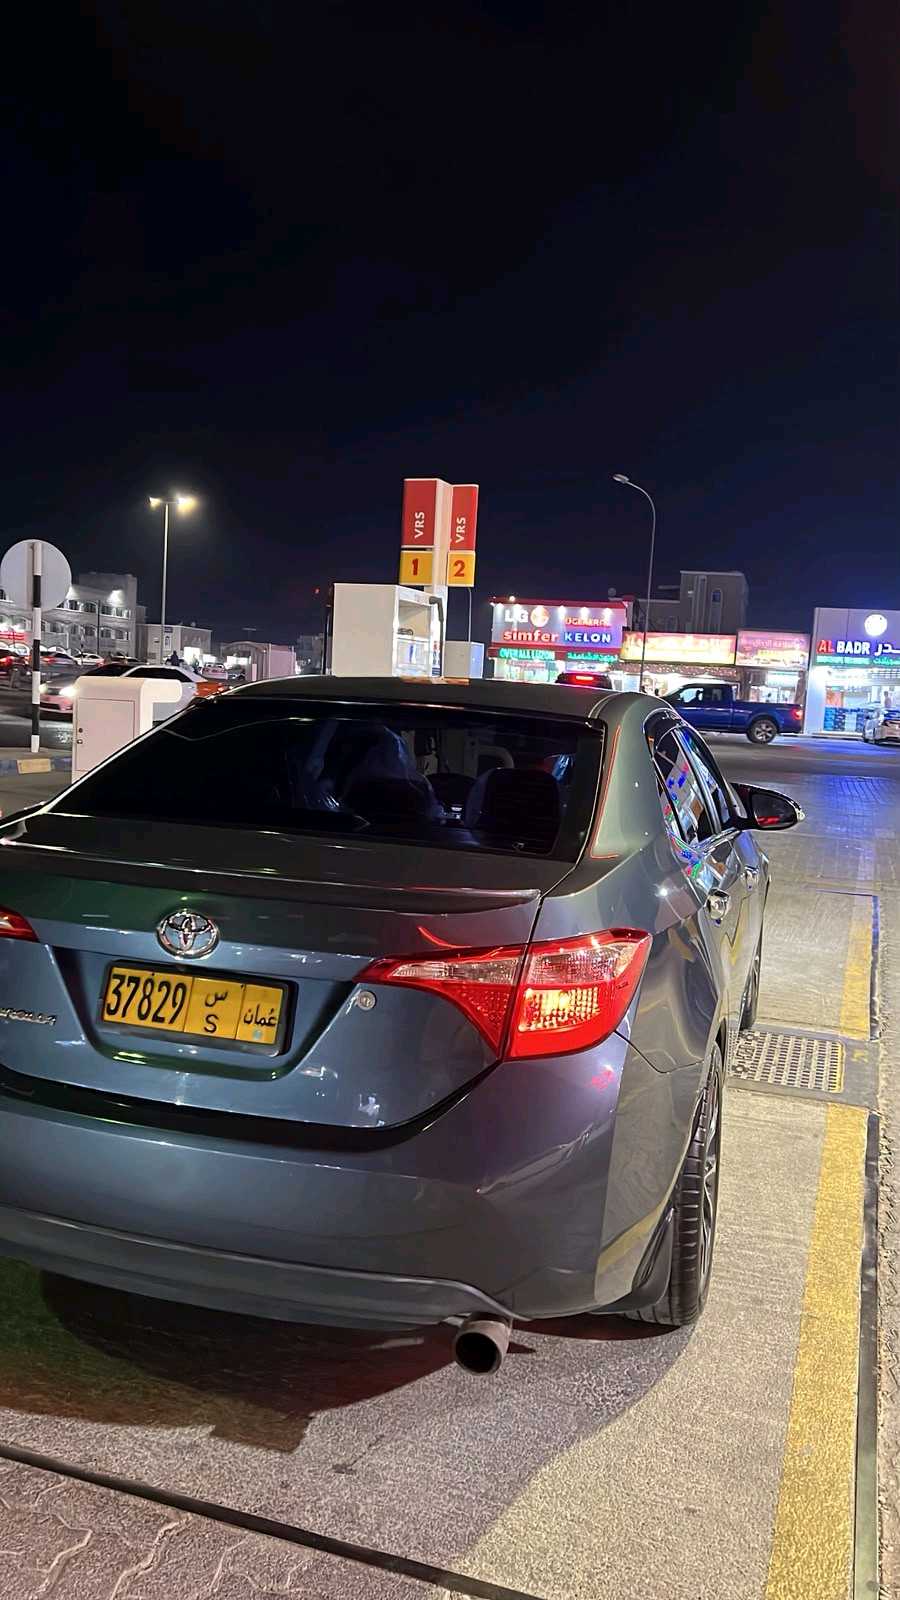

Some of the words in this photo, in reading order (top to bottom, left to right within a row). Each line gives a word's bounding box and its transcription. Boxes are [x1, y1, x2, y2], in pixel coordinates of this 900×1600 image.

[415, 511, 425, 539] VRS
[455, 516, 466, 543] VRS
[411, 558, 419, 576] 1
[453, 560, 466, 577] 2
[504, 609, 529, 623] LG
[503, 629, 559, 641] simfer
[564, 632, 611, 643] KELON
[818, 640, 834, 653] AL
[836, 641, 870, 654] BADR
[106, 974, 187, 1025] 37829
[204, 990, 229, 1008] س
[204, 1014, 219, 1033] S
